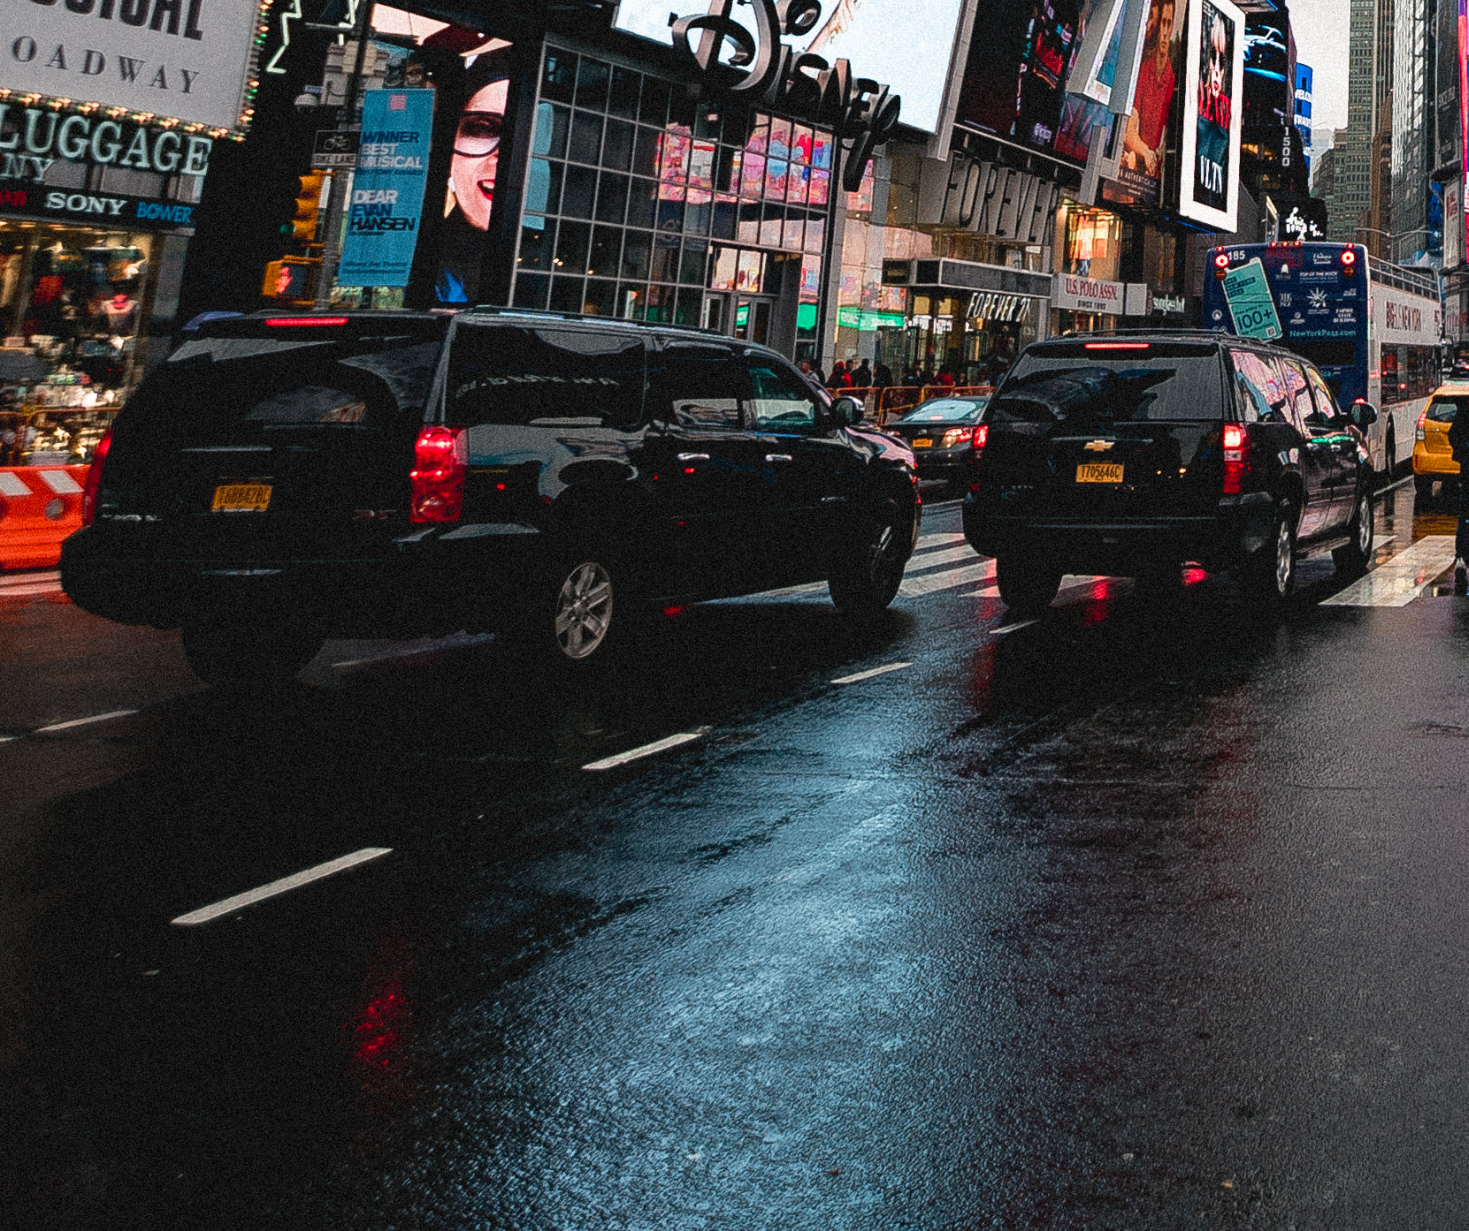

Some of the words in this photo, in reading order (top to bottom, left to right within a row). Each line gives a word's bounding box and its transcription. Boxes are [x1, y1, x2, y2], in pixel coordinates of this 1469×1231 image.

[0, 103, 213, 176] LUGGAGE
[362, 131, 420, 144] WINNER
[362, 143, 400, 156] BEST
[1282, 126, 1291, 167] 1500
[315, 155, 333, 165] BIKE
[334, 155, 355, 165] LANE
[360, 156, 423, 168] MUSICAL
[353, 189, 398, 204] DEAR
[45, 192, 128, 216] SONY
[351, 204, 393, 217] EVAN
[136, 201, 195, 223] BOWER
[350, 218, 415, 231] HANSEN
[1228, 250, 1245, 260] 185
[1065, 279, 1079, 296] U.S.
[1080, 282, 1099, 298] POLO
[967, 293, 1016, 321] FOREVER
[1236, 309, 1272, 330] 100+
[1289, 329, 1356, 338] NewYorkPass.com
